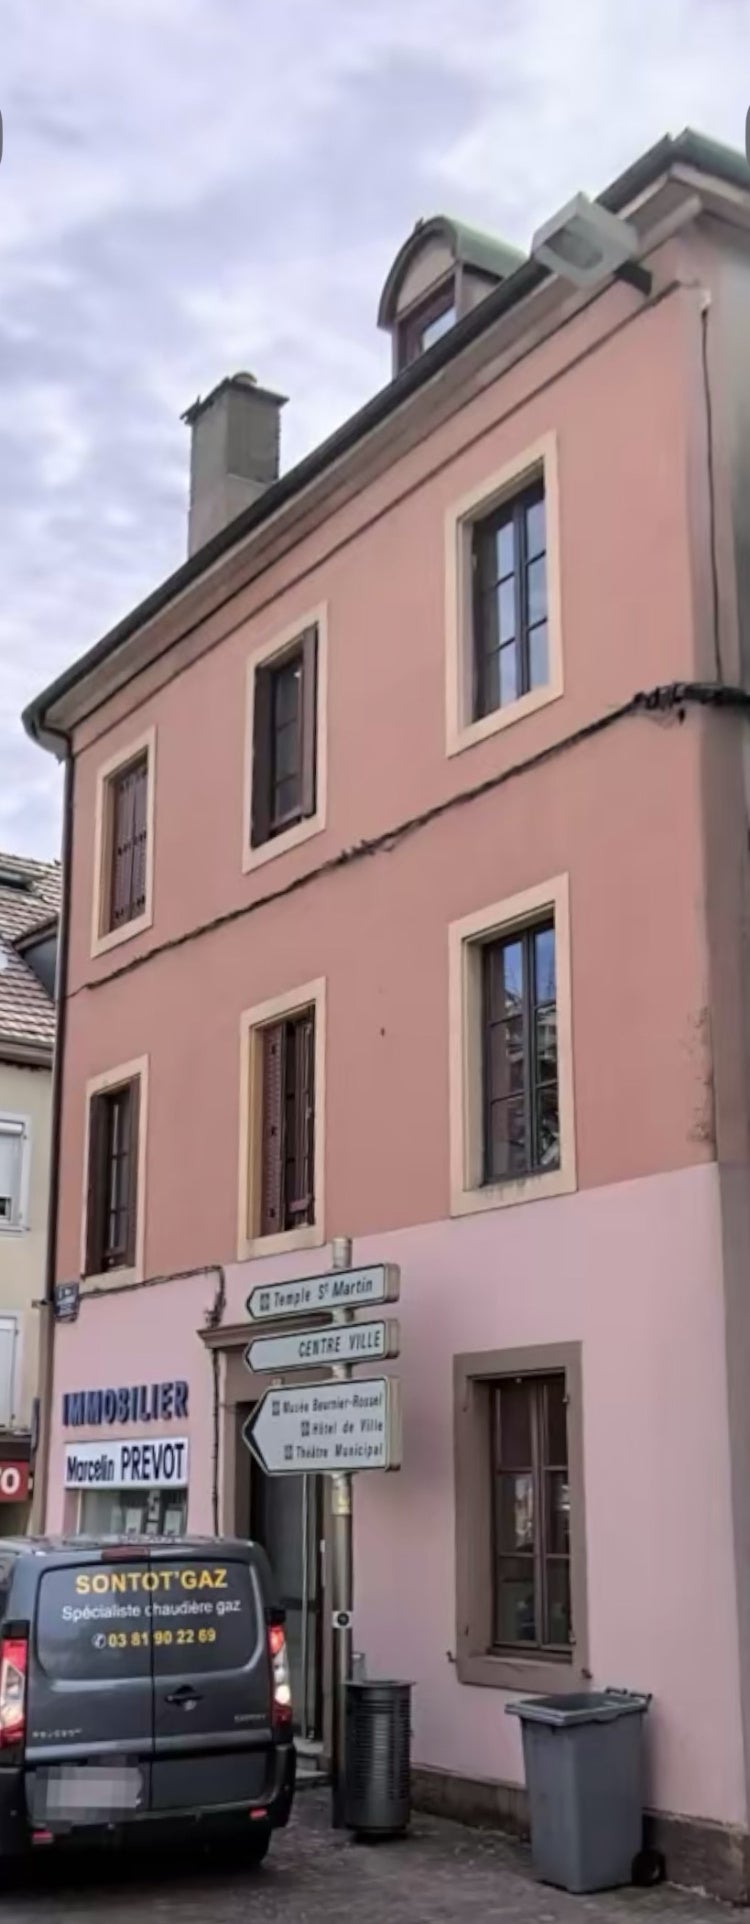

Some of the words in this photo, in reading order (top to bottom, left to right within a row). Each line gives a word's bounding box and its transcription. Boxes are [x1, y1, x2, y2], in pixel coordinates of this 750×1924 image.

[273, 1288, 311, 1308] Temple
[332, 1278, 373, 1296] Martin
[298, 1335, 341, 1357] CENTRE
[349, 1330, 381, 1350] VILLE
[62, 1381, 189, 1427] IMMOBILIER
[312, 1421, 337, 1435] Hôtel
[342, 1421, 354, 1433] de
[360, 1419, 383, 1432] Ville
[66, 1455, 115, 1482] Marcelin
[121, 1444, 184, 1481] PREVOT
[335, 1442, 382, 1459] Municipal
[75, 1568, 228, 1594] SONTOT'GAZ
[62, 1603, 141, 1622] Spécialiste
[144, 1600, 213, 1617] chaudière
[216, 1600, 241, 1616] gaz
[108, 1633, 127, 1648] 03
[131, 1632, 149, 1646] 81
[153, 1630, 172, 1645] 90
[176, 1629, 195, 1643] 22
[198, 1628, 216, 1643] 69
